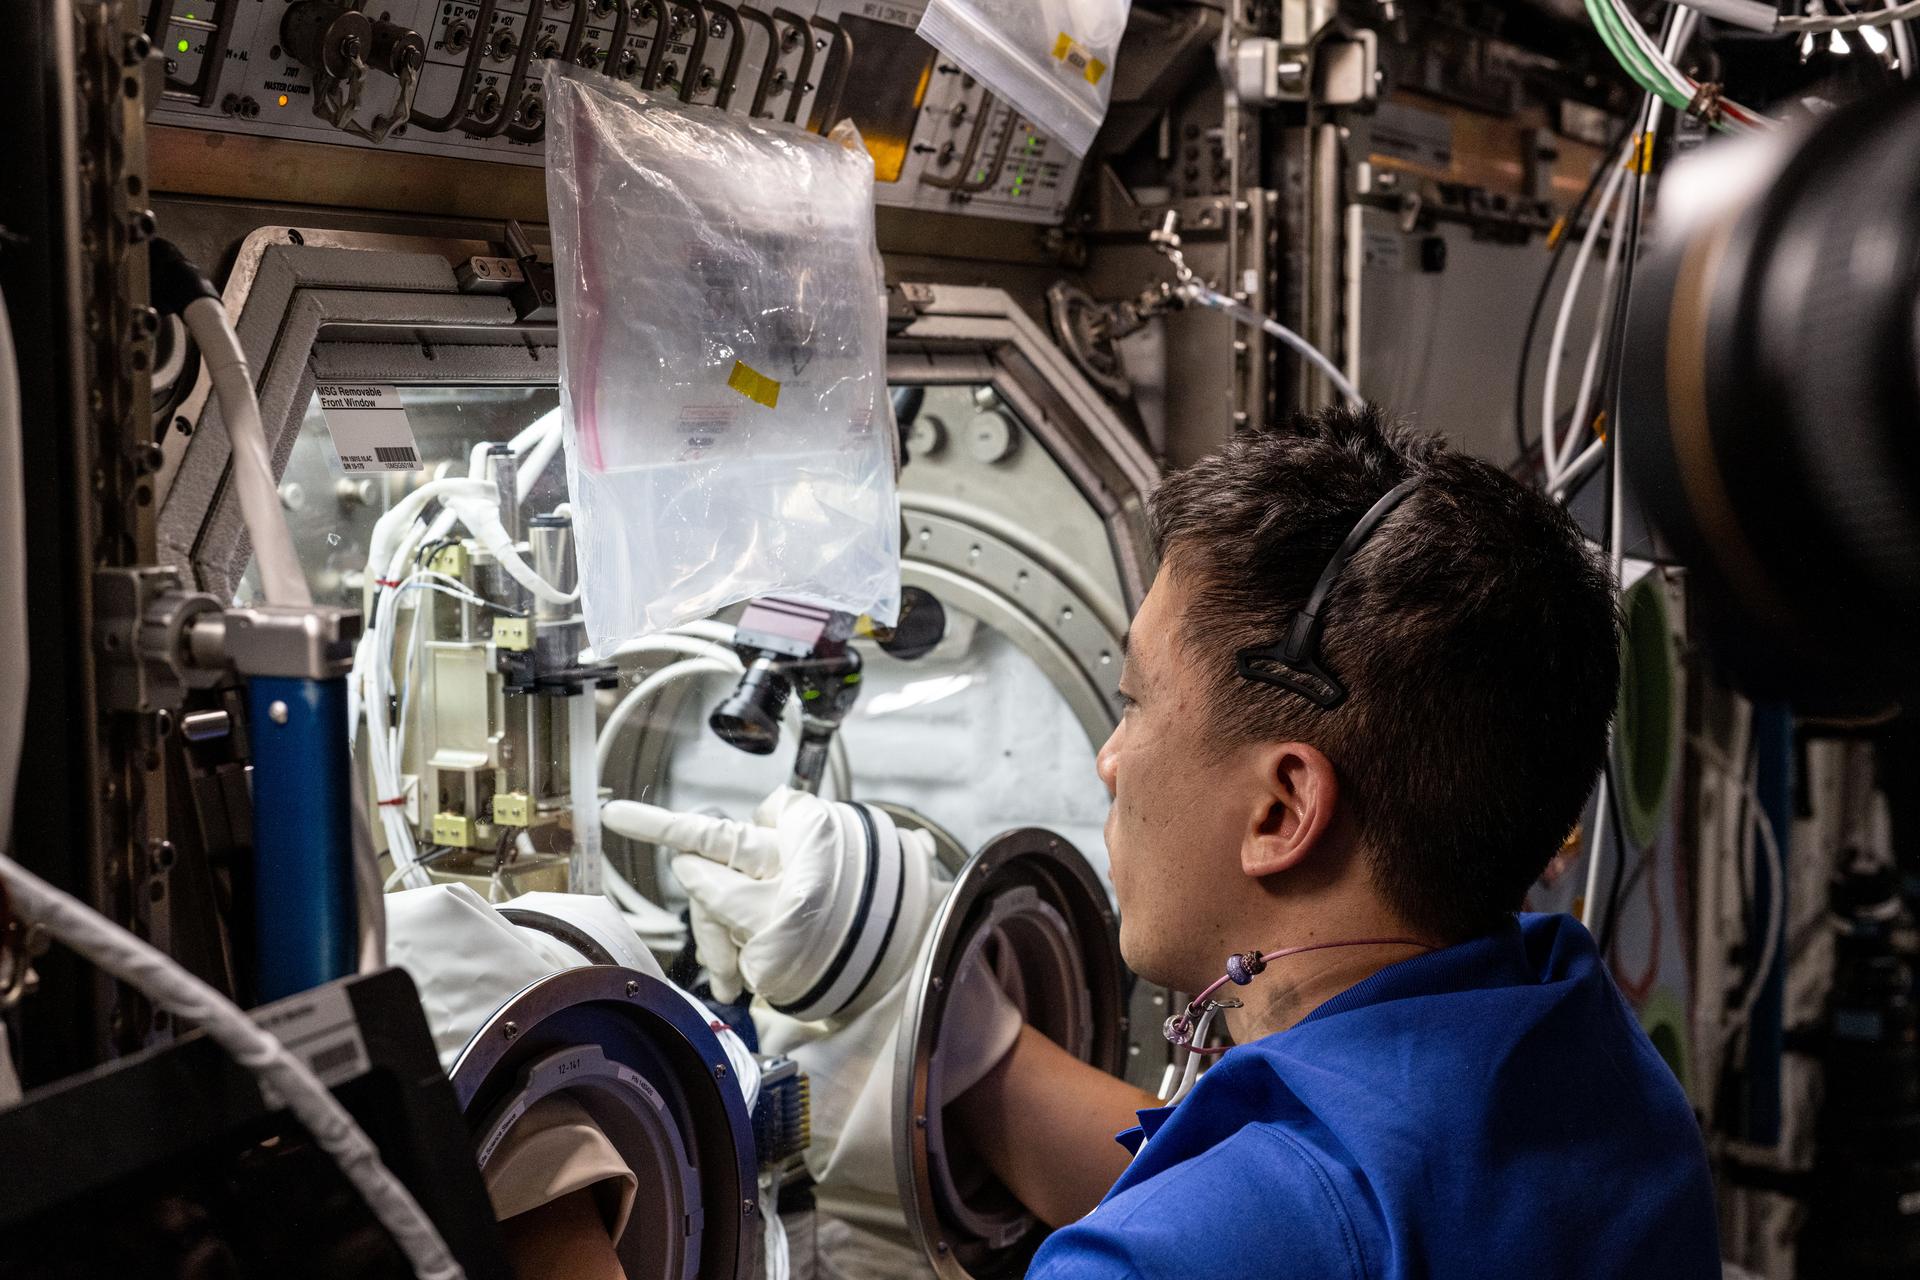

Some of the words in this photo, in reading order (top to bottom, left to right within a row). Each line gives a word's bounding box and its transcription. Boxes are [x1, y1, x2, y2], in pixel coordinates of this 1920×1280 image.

[586, 28, 600, 40] MODE
[264, 80, 287, 92] MASTER
[287, 83, 311, 95] CAUTION
[316, 386, 337, 397] MSG
[339, 387, 382, 397] Removable
[321, 398, 344, 408] Front
[345, 399, 376, 408] Window
